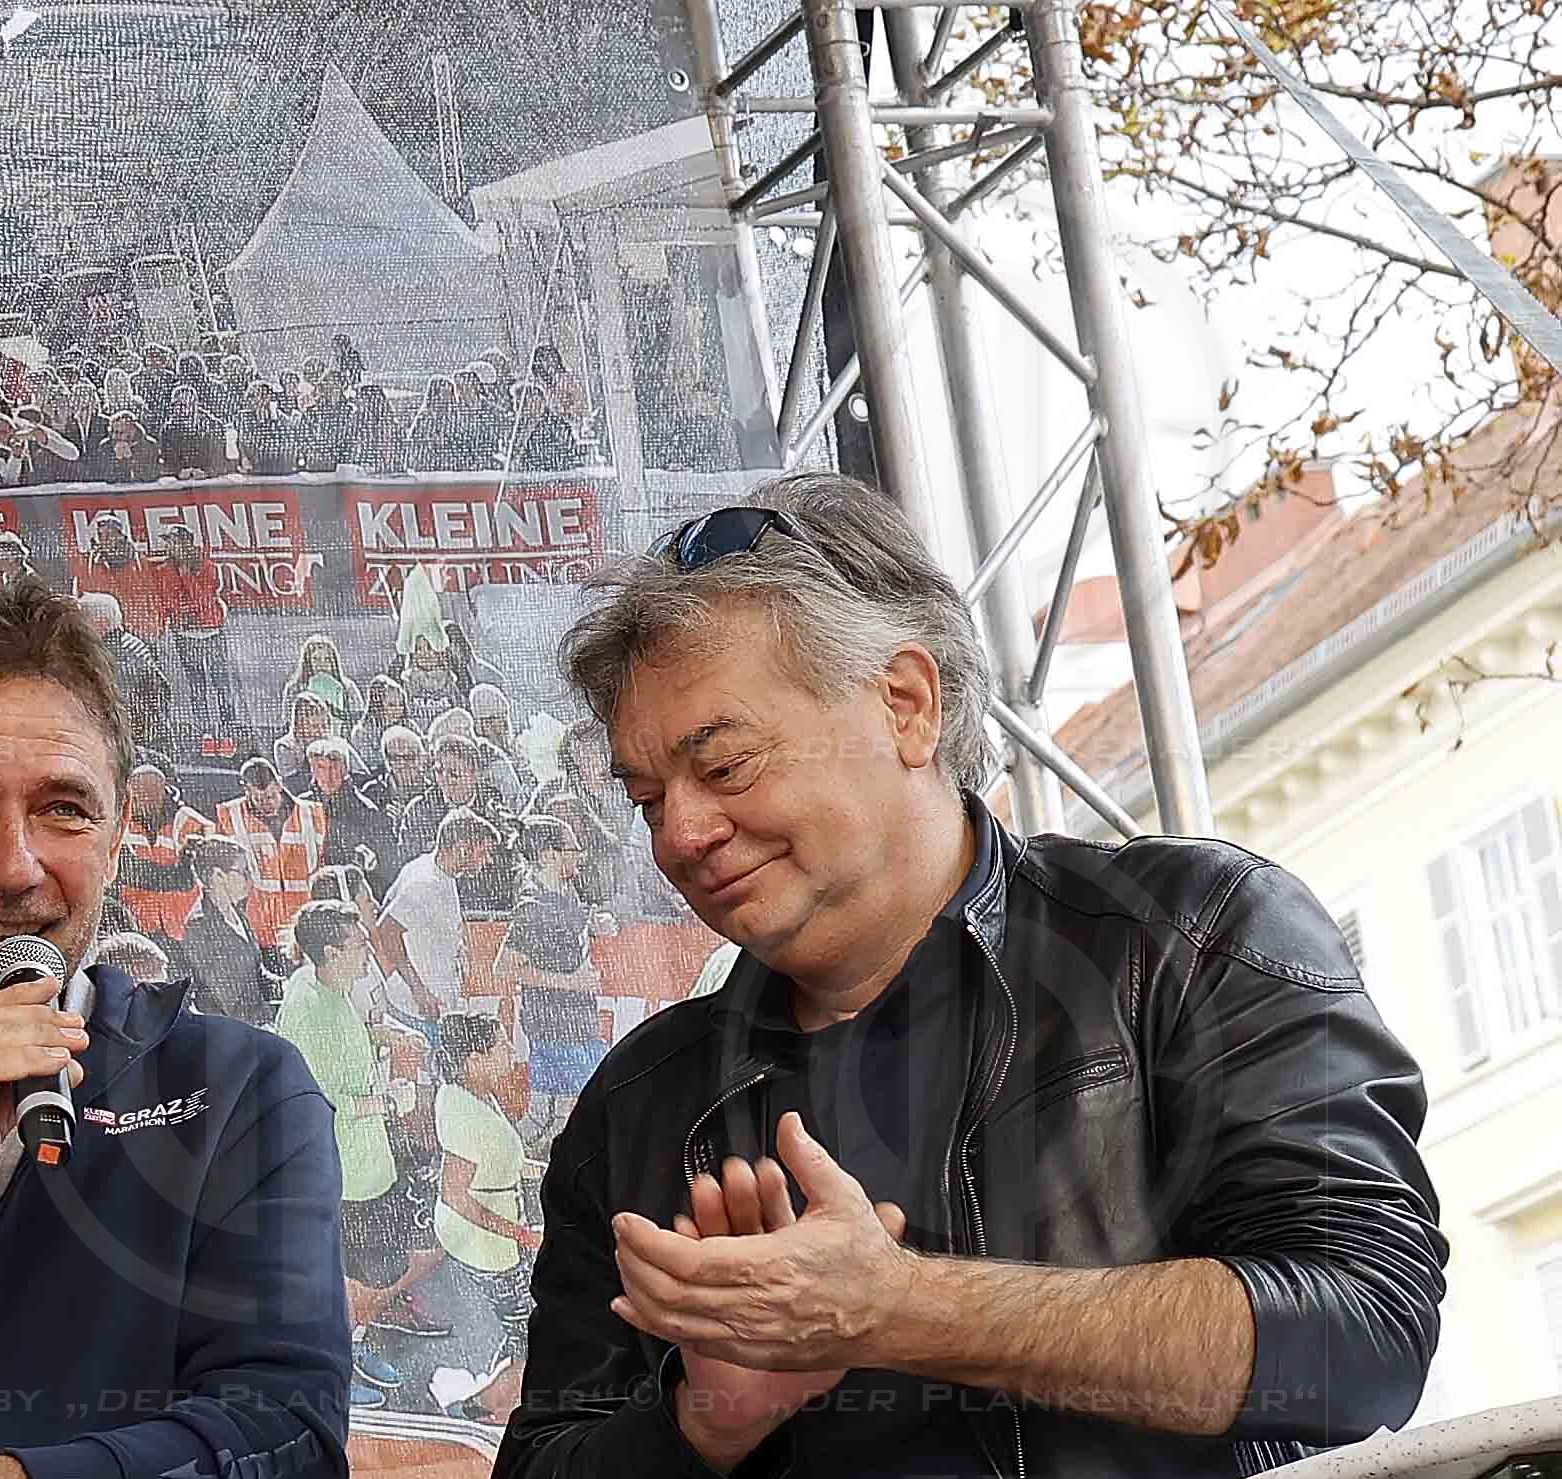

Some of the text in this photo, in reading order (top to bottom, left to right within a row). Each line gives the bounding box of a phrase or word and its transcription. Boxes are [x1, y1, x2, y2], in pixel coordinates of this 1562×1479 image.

[356, 499, 589, 549] KLEINE
[119, 1098, 182, 1125] GRAZ
[104, 1117, 166, 1136] MARATHON
